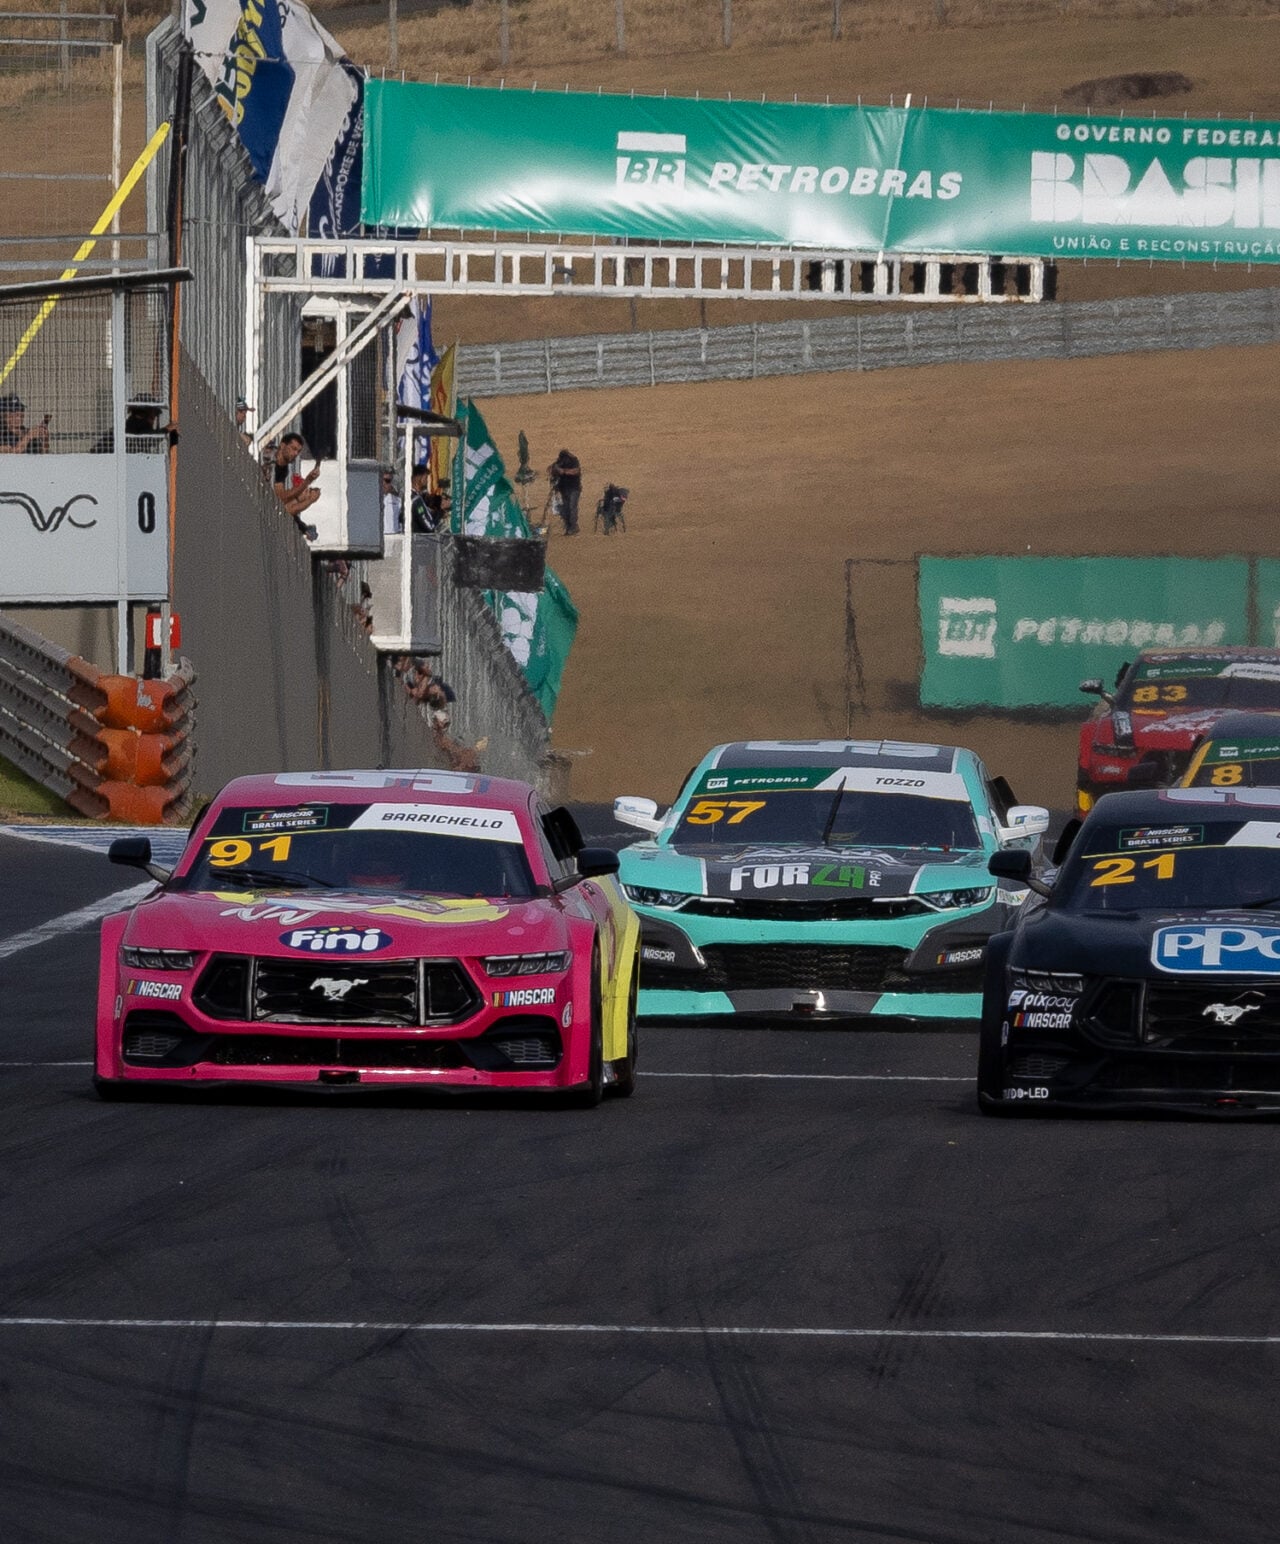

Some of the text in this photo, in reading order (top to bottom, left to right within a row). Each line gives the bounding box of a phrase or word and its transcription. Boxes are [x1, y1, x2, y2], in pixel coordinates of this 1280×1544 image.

[1056, 124, 1171, 144] GOVERNO
[708, 161, 963, 200] PETROBRAS
[1052, 235, 1111, 251] UNIÃO
[1120, 238, 1130, 251] E
[1133, 685, 1188, 702] 83
[734, 776, 808, 785] PETROBRAS
[875, 777, 926, 788] TOZZO
[1210, 765, 1243, 786] 8
[270, 810, 314, 820] NASCAR
[381, 812, 504, 830] BARRICHELLO
[686, 800, 767, 824] 57
[252, 818, 317, 830] BRASIL SERIES
[1147, 827, 1190, 836] NASCAR
[1127, 836, 1195, 846] BRASIL SERIES
[209, 835, 292, 867] 91
[729, 862, 867, 892] FORZA
[1090, 853, 1177, 887] 21
[290, 926, 382, 951] Fini
[644, 947, 676, 962] NASCAR
[948, 948, 983, 963] NASCAR
[138, 980, 183, 1000] NASCAR
[508, 987, 555, 1007] NASCAR
[1023, 991, 1079, 1013] pixpay
[1027, 1012, 1072, 1028] NASCAR
